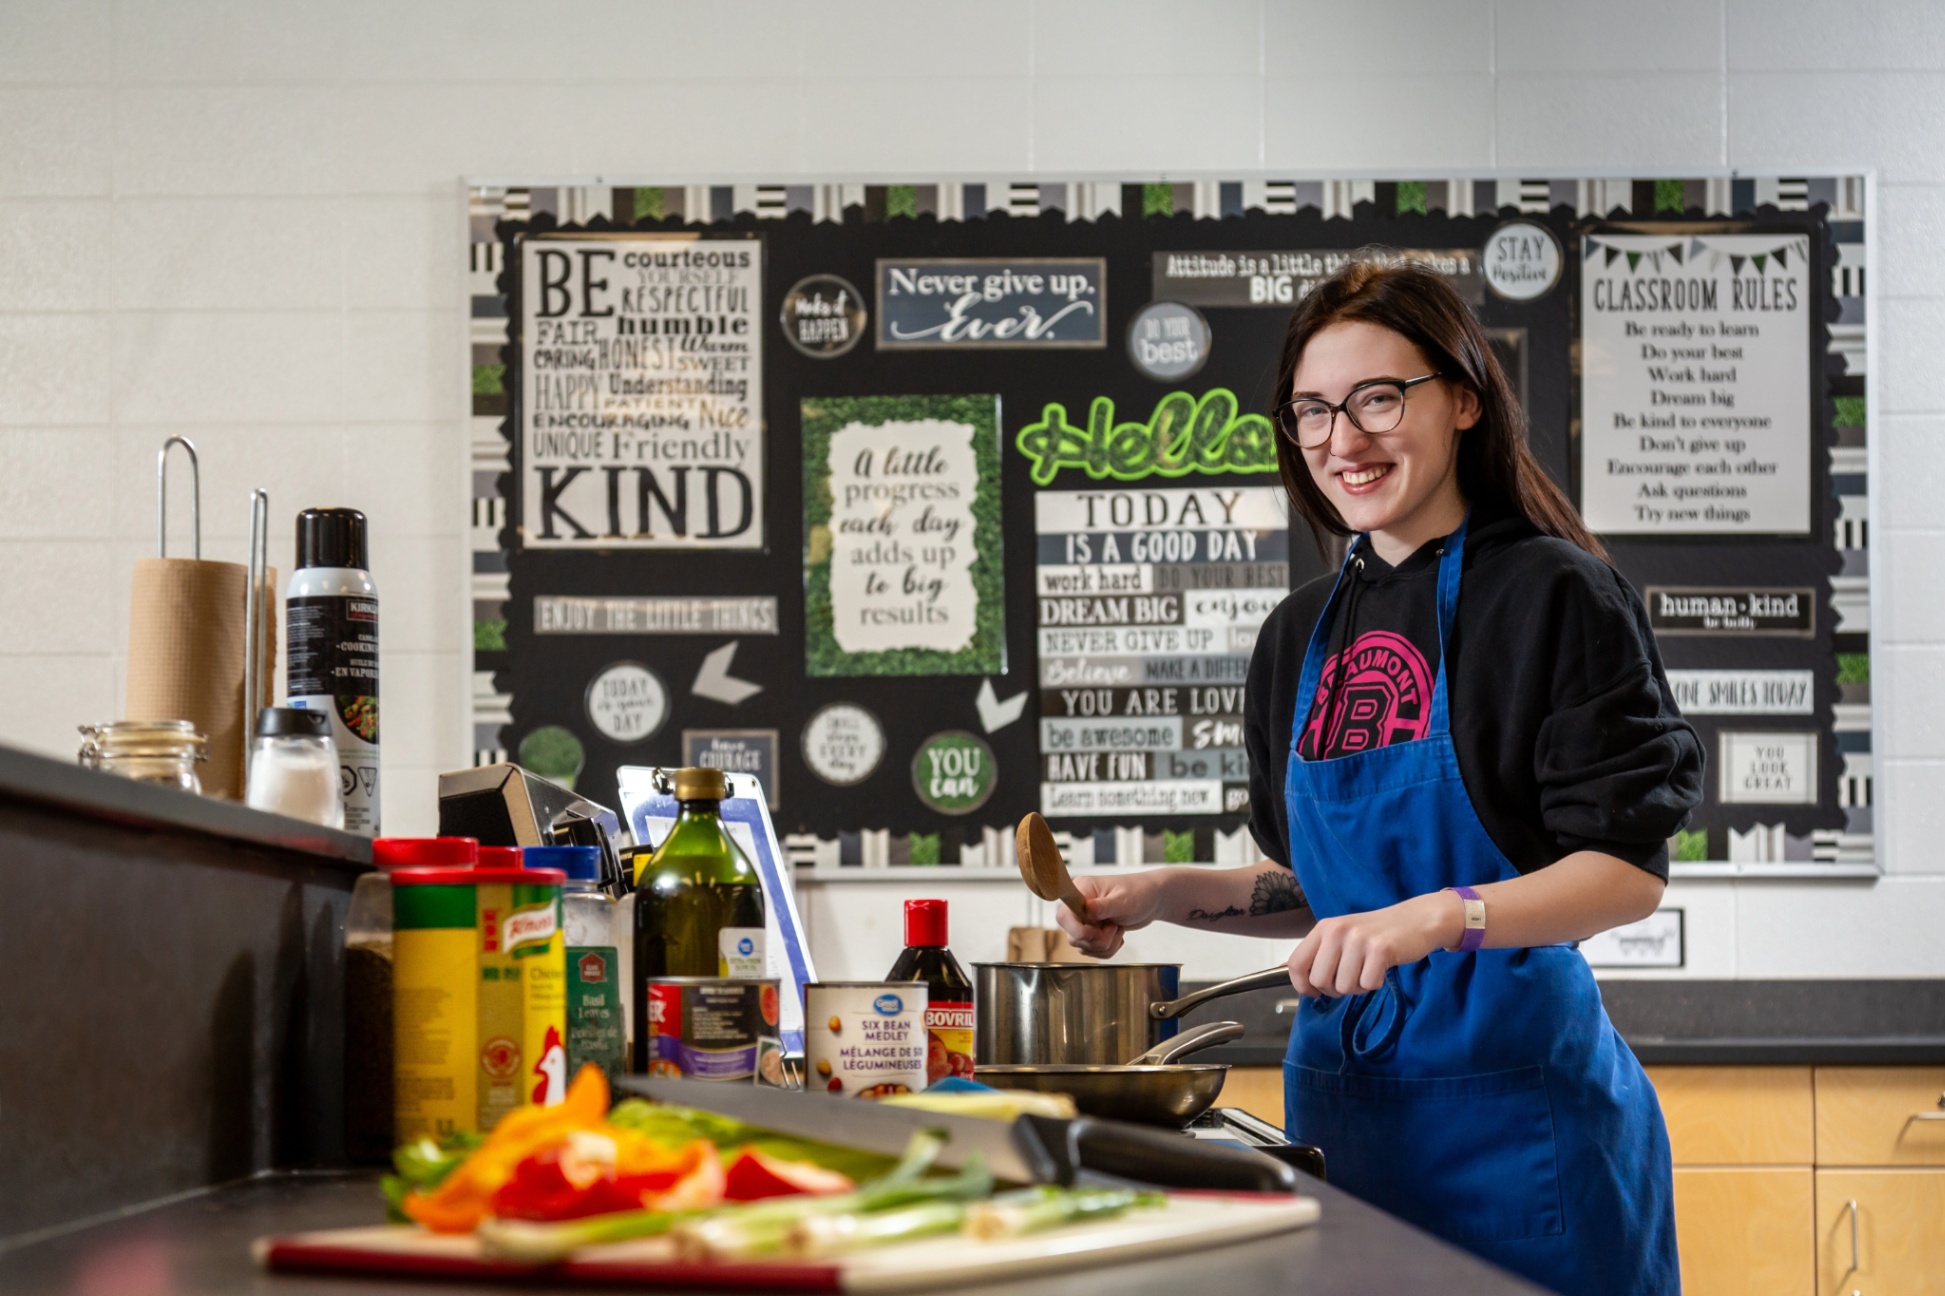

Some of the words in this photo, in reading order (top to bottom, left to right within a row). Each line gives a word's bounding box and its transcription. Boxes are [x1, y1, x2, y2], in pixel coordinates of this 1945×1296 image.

[624, 248, 750, 269] courteous
[1497, 235, 1546, 261] STAY
[1166, 254, 1236, 278] Attitude
[1237, 254, 1257, 277] is
[1258, 257, 1271, 276] a
[1271, 253, 1323, 277] little
[534, 250, 616, 318] BE
[888, 268, 979, 296] Never
[983, 268, 1044, 301] give
[1050, 274, 1096, 301] up.
[1250, 275, 1294, 303] BIG
[1594, 277, 1718, 312] CLASSROOM
[1732, 277, 1798, 312] RULES
[622, 286, 748, 314] RESPECTFUL
[617, 314, 748, 336] humble
[890, 292, 1094, 342] Ever.
[1624, 319, 1647, 338] Be
[1651, 320, 1695, 340] ready
[1699, 322, 1716, 338] to
[1719, 319, 1760, 338] learn
[536, 320, 599, 346] FAIR
[534, 348, 596, 370] CARING
[599, 336, 676, 371] HONEST
[1140, 336, 1198, 365] best
[1641, 343, 1667, 361] Do
[1671, 347, 1708, 365] your
[1711, 343, 1743, 361] best
[677, 356, 751, 372] SWEET
[1647, 366, 1696, 384] Work
[1700, 366, 1737, 384] hard
[535, 373, 603, 410] HAPPY
[609, 373, 748, 402] Understanding
[1650, 389, 1707, 407] Dream
[1710, 389, 1735, 408] big
[534, 412, 690, 430] ENCOURAGING
[1613, 412, 1636, 430] Be
[1640, 412, 1676, 430] kind
[1680, 414, 1697, 430] to
[1700, 416, 1772, 434] everyone
[533, 431, 602, 460] UNIQUE
[613, 431, 751, 470] Friendly
[1690, 437, 1720, 455] give
[1724, 439, 1747, 456] up
[853, 447, 875, 479] A
[883, 445, 950, 476] little
[1607, 458, 1690, 478] Encourage
[1695, 458, 1732, 476] each
[1736, 458, 1778, 476] other
[533, 465, 754, 541] KIND
[845, 480, 960, 508] progress
[1638, 481, 1668, 498] Ask
[1673, 482, 1748, 502] questions
[1077, 491, 1243, 528] TODAY
[1634, 505, 1665, 525] Try
[1668, 508, 1700, 523] new
[1704, 504, 1751, 525] things
[838, 506, 898, 535] each
[912, 504, 964, 542] day
[851, 541, 914, 566] adds
[922, 548, 956, 570] up
[1066, 534, 1093, 564] IS
[1102, 533, 1122, 563] A
[1131, 531, 1198, 563] GOOD
[1206, 531, 1258, 562] DAY
[865, 572, 889, 596] to
[902, 565, 945, 603] big
[1044, 567, 1092, 592] work
[1098, 566, 1143, 590] hard
[1160, 567, 1181, 589] DO
[1191, 565, 1234, 588] YOUR
[1244, 564, 1285, 588] BEST
[541, 601, 596, 630] ENJOY
[606, 602, 637, 629] THE
[645, 602, 703, 630] LITTLE
[710, 601, 772, 629] THINGS
[860, 601, 950, 626] results
[1039, 596, 1130, 626] DREAM
[1134, 596, 1179, 623] BIG
[1046, 630, 1118, 653] NEVER
[1124, 629, 1180, 652] GIVE
[1186, 629, 1215, 651] UP
[1146, 659, 1186, 682] MAKE
[1189, 659, 1201, 681] A
[602, 678, 648, 698] TODAY
[1708, 680, 1758, 706] SMILES
[1764, 680, 1808, 706] TODAY
[1062, 689, 1114, 716] YOU
[1125, 688, 1179, 715] ARE
[613, 713, 642, 733] DAY
[1049, 724, 1075, 749] be
[1080, 726, 1175, 748] awesome
[927, 747, 982, 778] YOU
[1756, 746, 1785, 759] YOU
[1048, 753, 1101, 782] HAVE
[1106, 753, 1147, 781] FUN
[1169, 753, 1209, 779] be
[930, 777, 980, 799] can
[1097, 784, 1179, 813] something
[582, 993, 606, 1007] Basil
[861, 1020, 880, 1031] SIX
[883, 1020, 911, 1031] BEAN
[926, 1011, 974, 1028] BOVRIL
[865, 1031, 909, 1042] MEDLEY
[840, 1046, 896, 1058] MÉLANGE
[899, 1047, 911, 1058] DE
[842, 1059, 922, 1071] LÉGUMINEUSES
